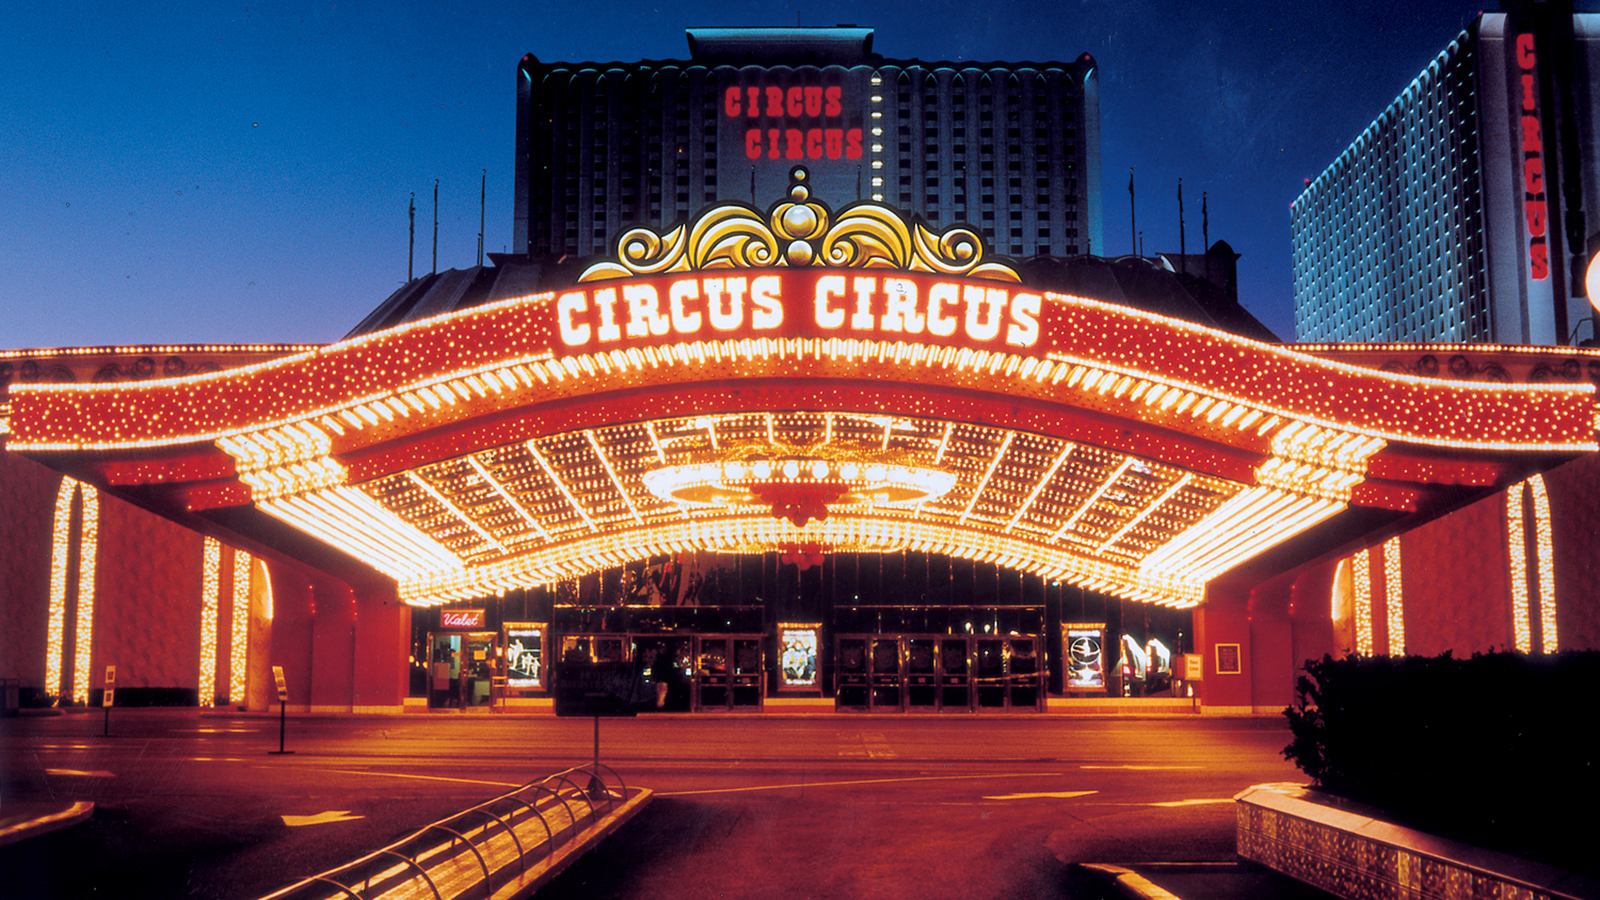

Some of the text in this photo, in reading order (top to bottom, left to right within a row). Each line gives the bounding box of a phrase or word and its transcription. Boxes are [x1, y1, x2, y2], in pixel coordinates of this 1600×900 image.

[725, 86, 842, 118] CIRCUS
[745, 128, 863, 160] CIRCUS
[1516, 33, 1549, 280] CIRCUS
[557, 275, 1043, 348] CIRCUS CIRCUS
[443, 612, 479, 627] Valet
